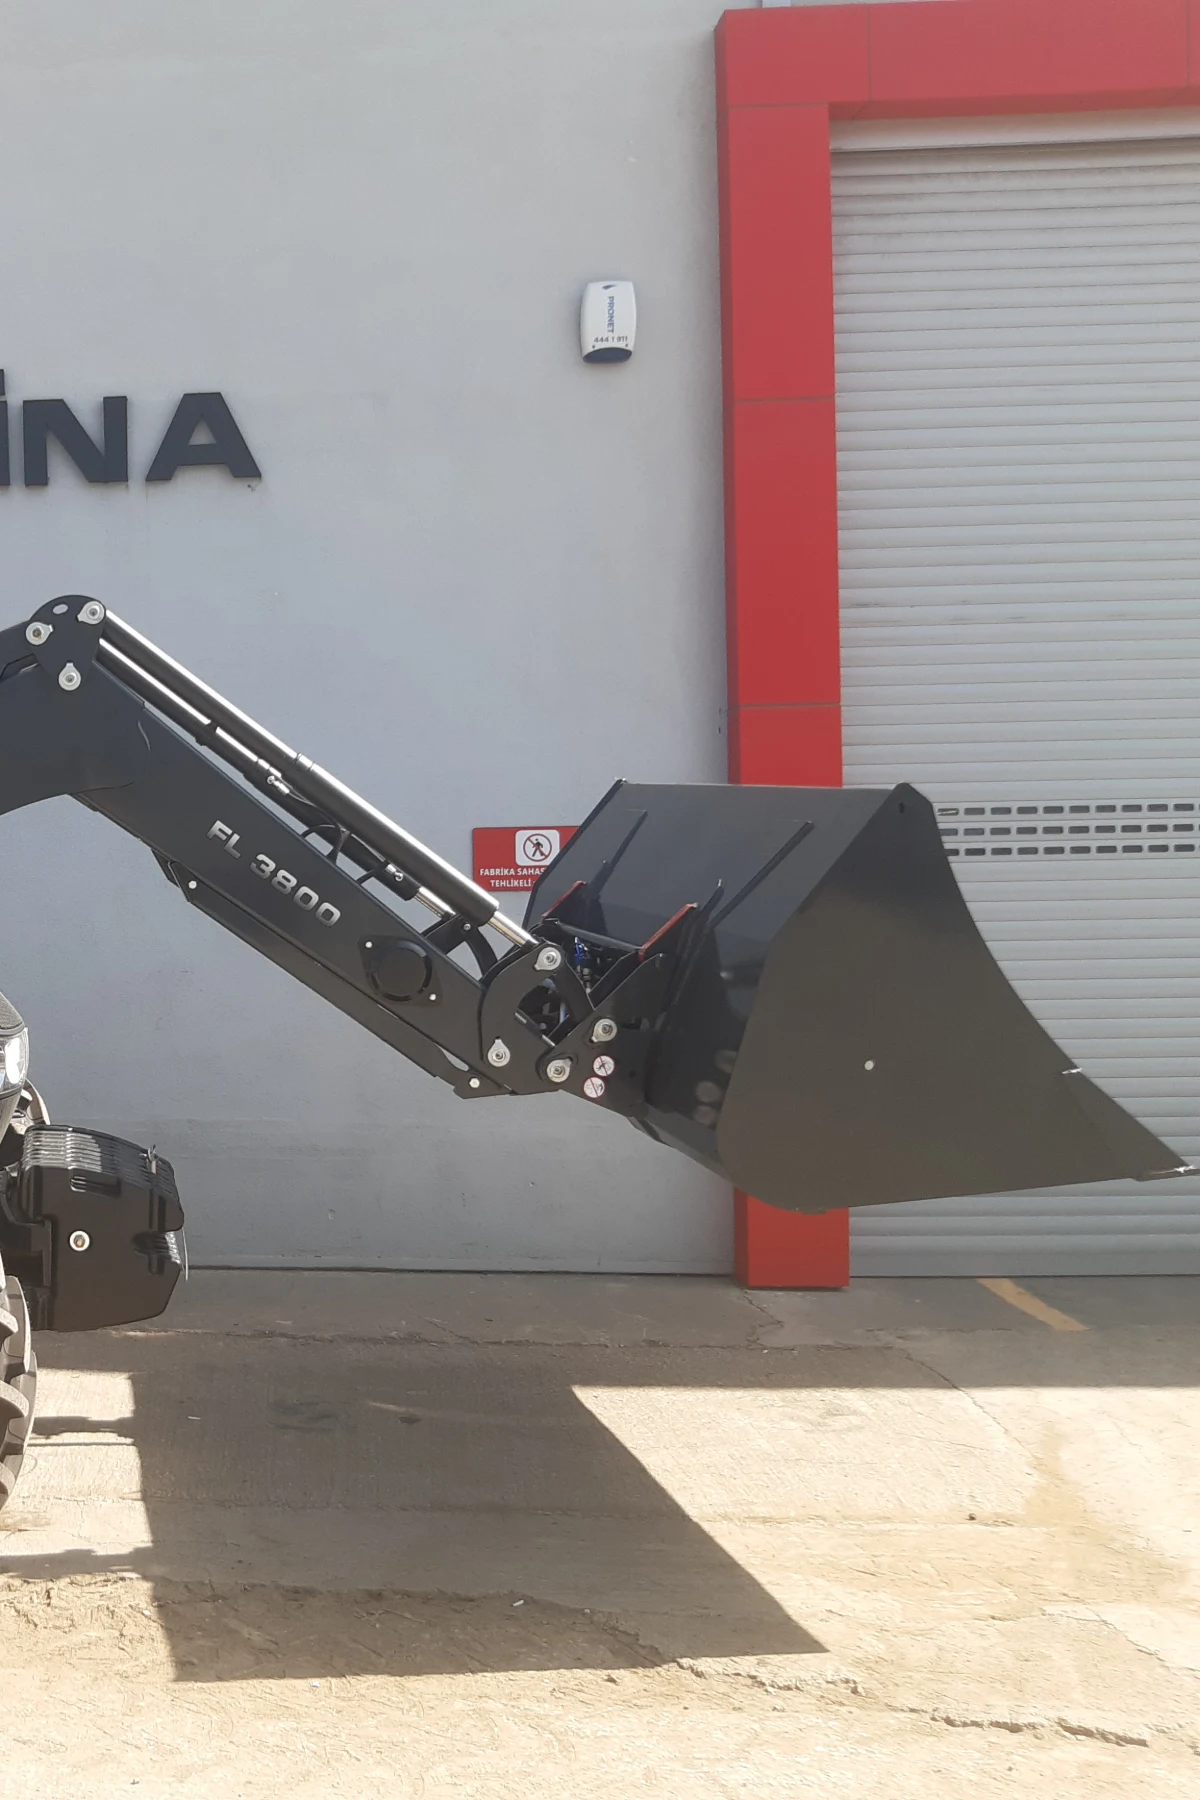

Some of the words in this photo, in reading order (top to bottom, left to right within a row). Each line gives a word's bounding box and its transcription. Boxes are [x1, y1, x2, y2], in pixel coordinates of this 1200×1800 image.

[607, 296, 615, 333] PRONET
[206, 820, 241, 859] FL
[249, 853, 341, 927] 3800
[479, 867, 515, 876] FABRİKA
[517, 867, 546, 876] SAHAS
[490, 878, 531, 887] TEHLİKELİ
